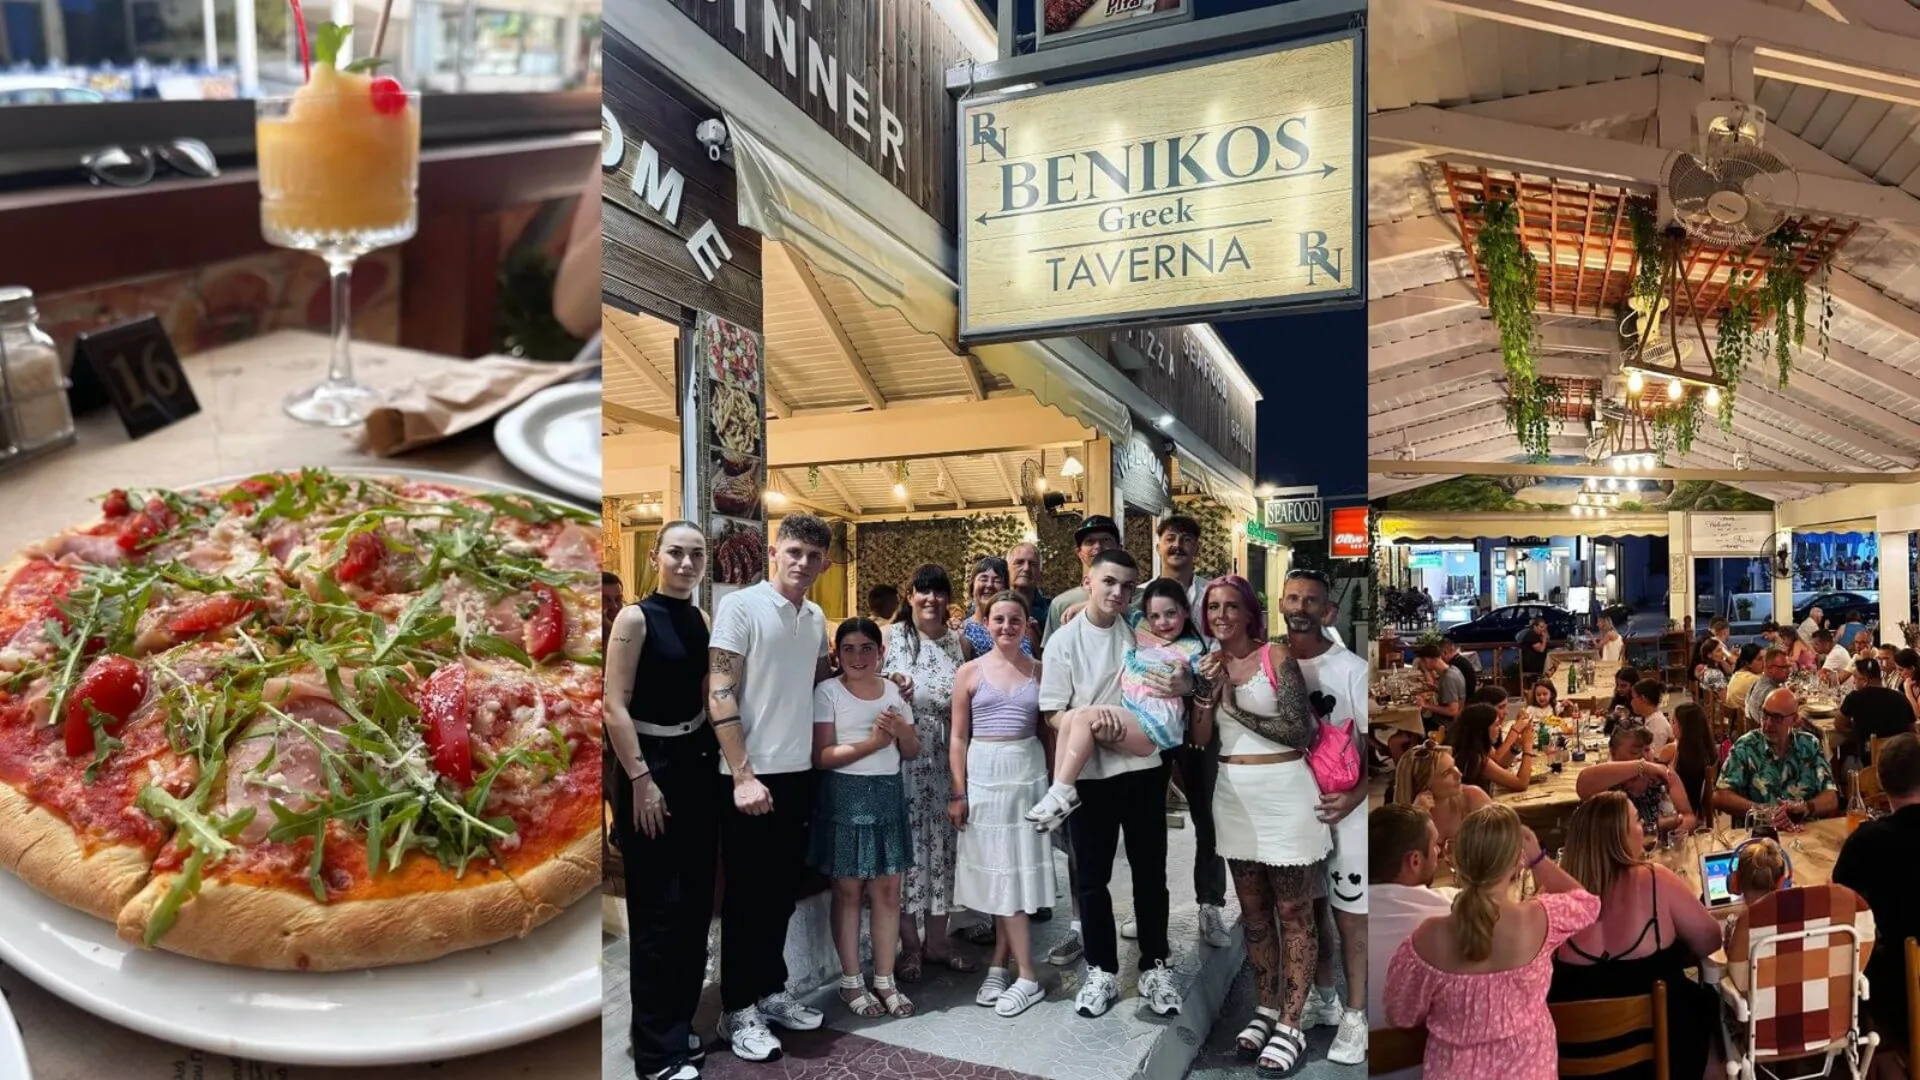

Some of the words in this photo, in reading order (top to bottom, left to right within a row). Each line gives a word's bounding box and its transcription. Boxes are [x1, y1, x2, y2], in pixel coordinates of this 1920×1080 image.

[706, 0, 905, 173] INNER
[999, 117, 1310, 213] BENIKOS
[1098, 198, 1195, 233] Greek
[1046, 235, 1252, 292] TAVERNA
[109, 342, 178, 409] 16
[1183, 331, 1227, 400] SEAFOOD
[1268, 501, 1320, 523] SEAFOOD
